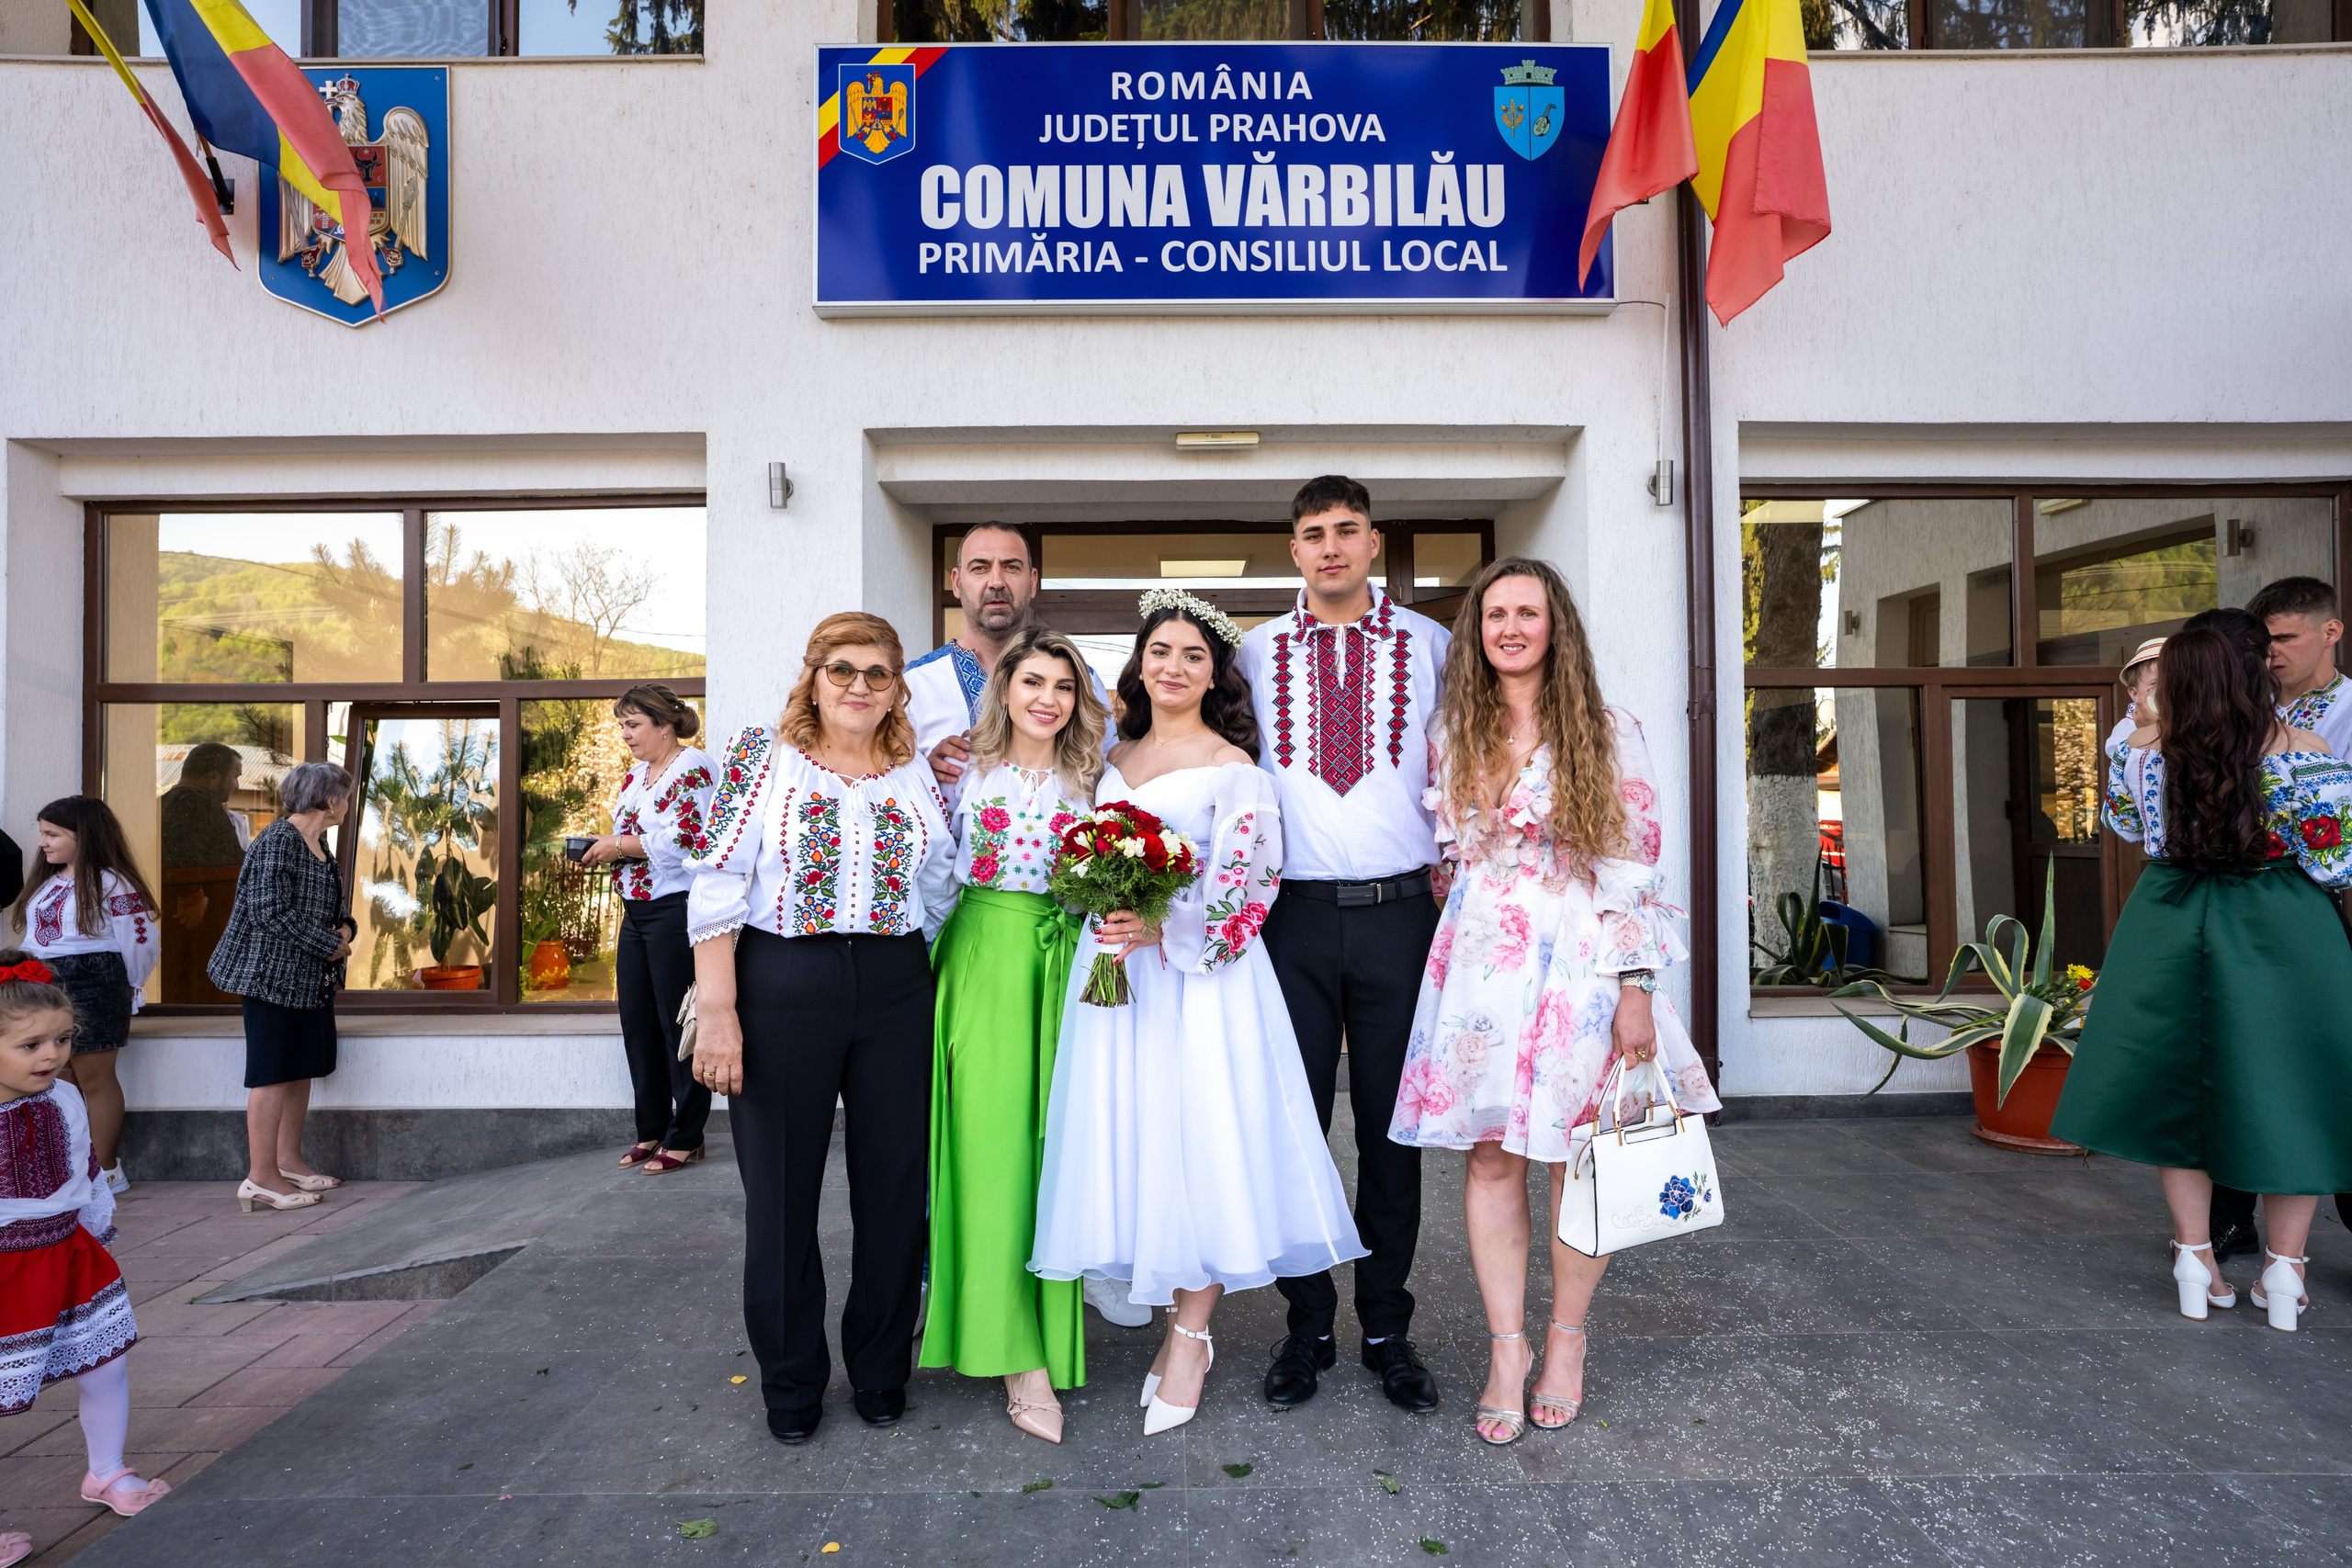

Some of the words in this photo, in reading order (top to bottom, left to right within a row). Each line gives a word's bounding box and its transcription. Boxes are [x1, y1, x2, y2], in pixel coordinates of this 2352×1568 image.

[1112, 63, 1313, 100] ROMÂNIA
[1039, 113, 1199, 150] JUDEȚUL
[1210, 113, 1386, 142] PRAHOVA
[921, 164, 1192, 230] COMUNA
[1202, 151, 1506, 228] VĂRBILĂU
[919, 232, 1124, 274] PRIMĂRIA
[1160, 240, 1371, 273] CONSILIUL
[1383, 240, 1509, 272] LOCAL
